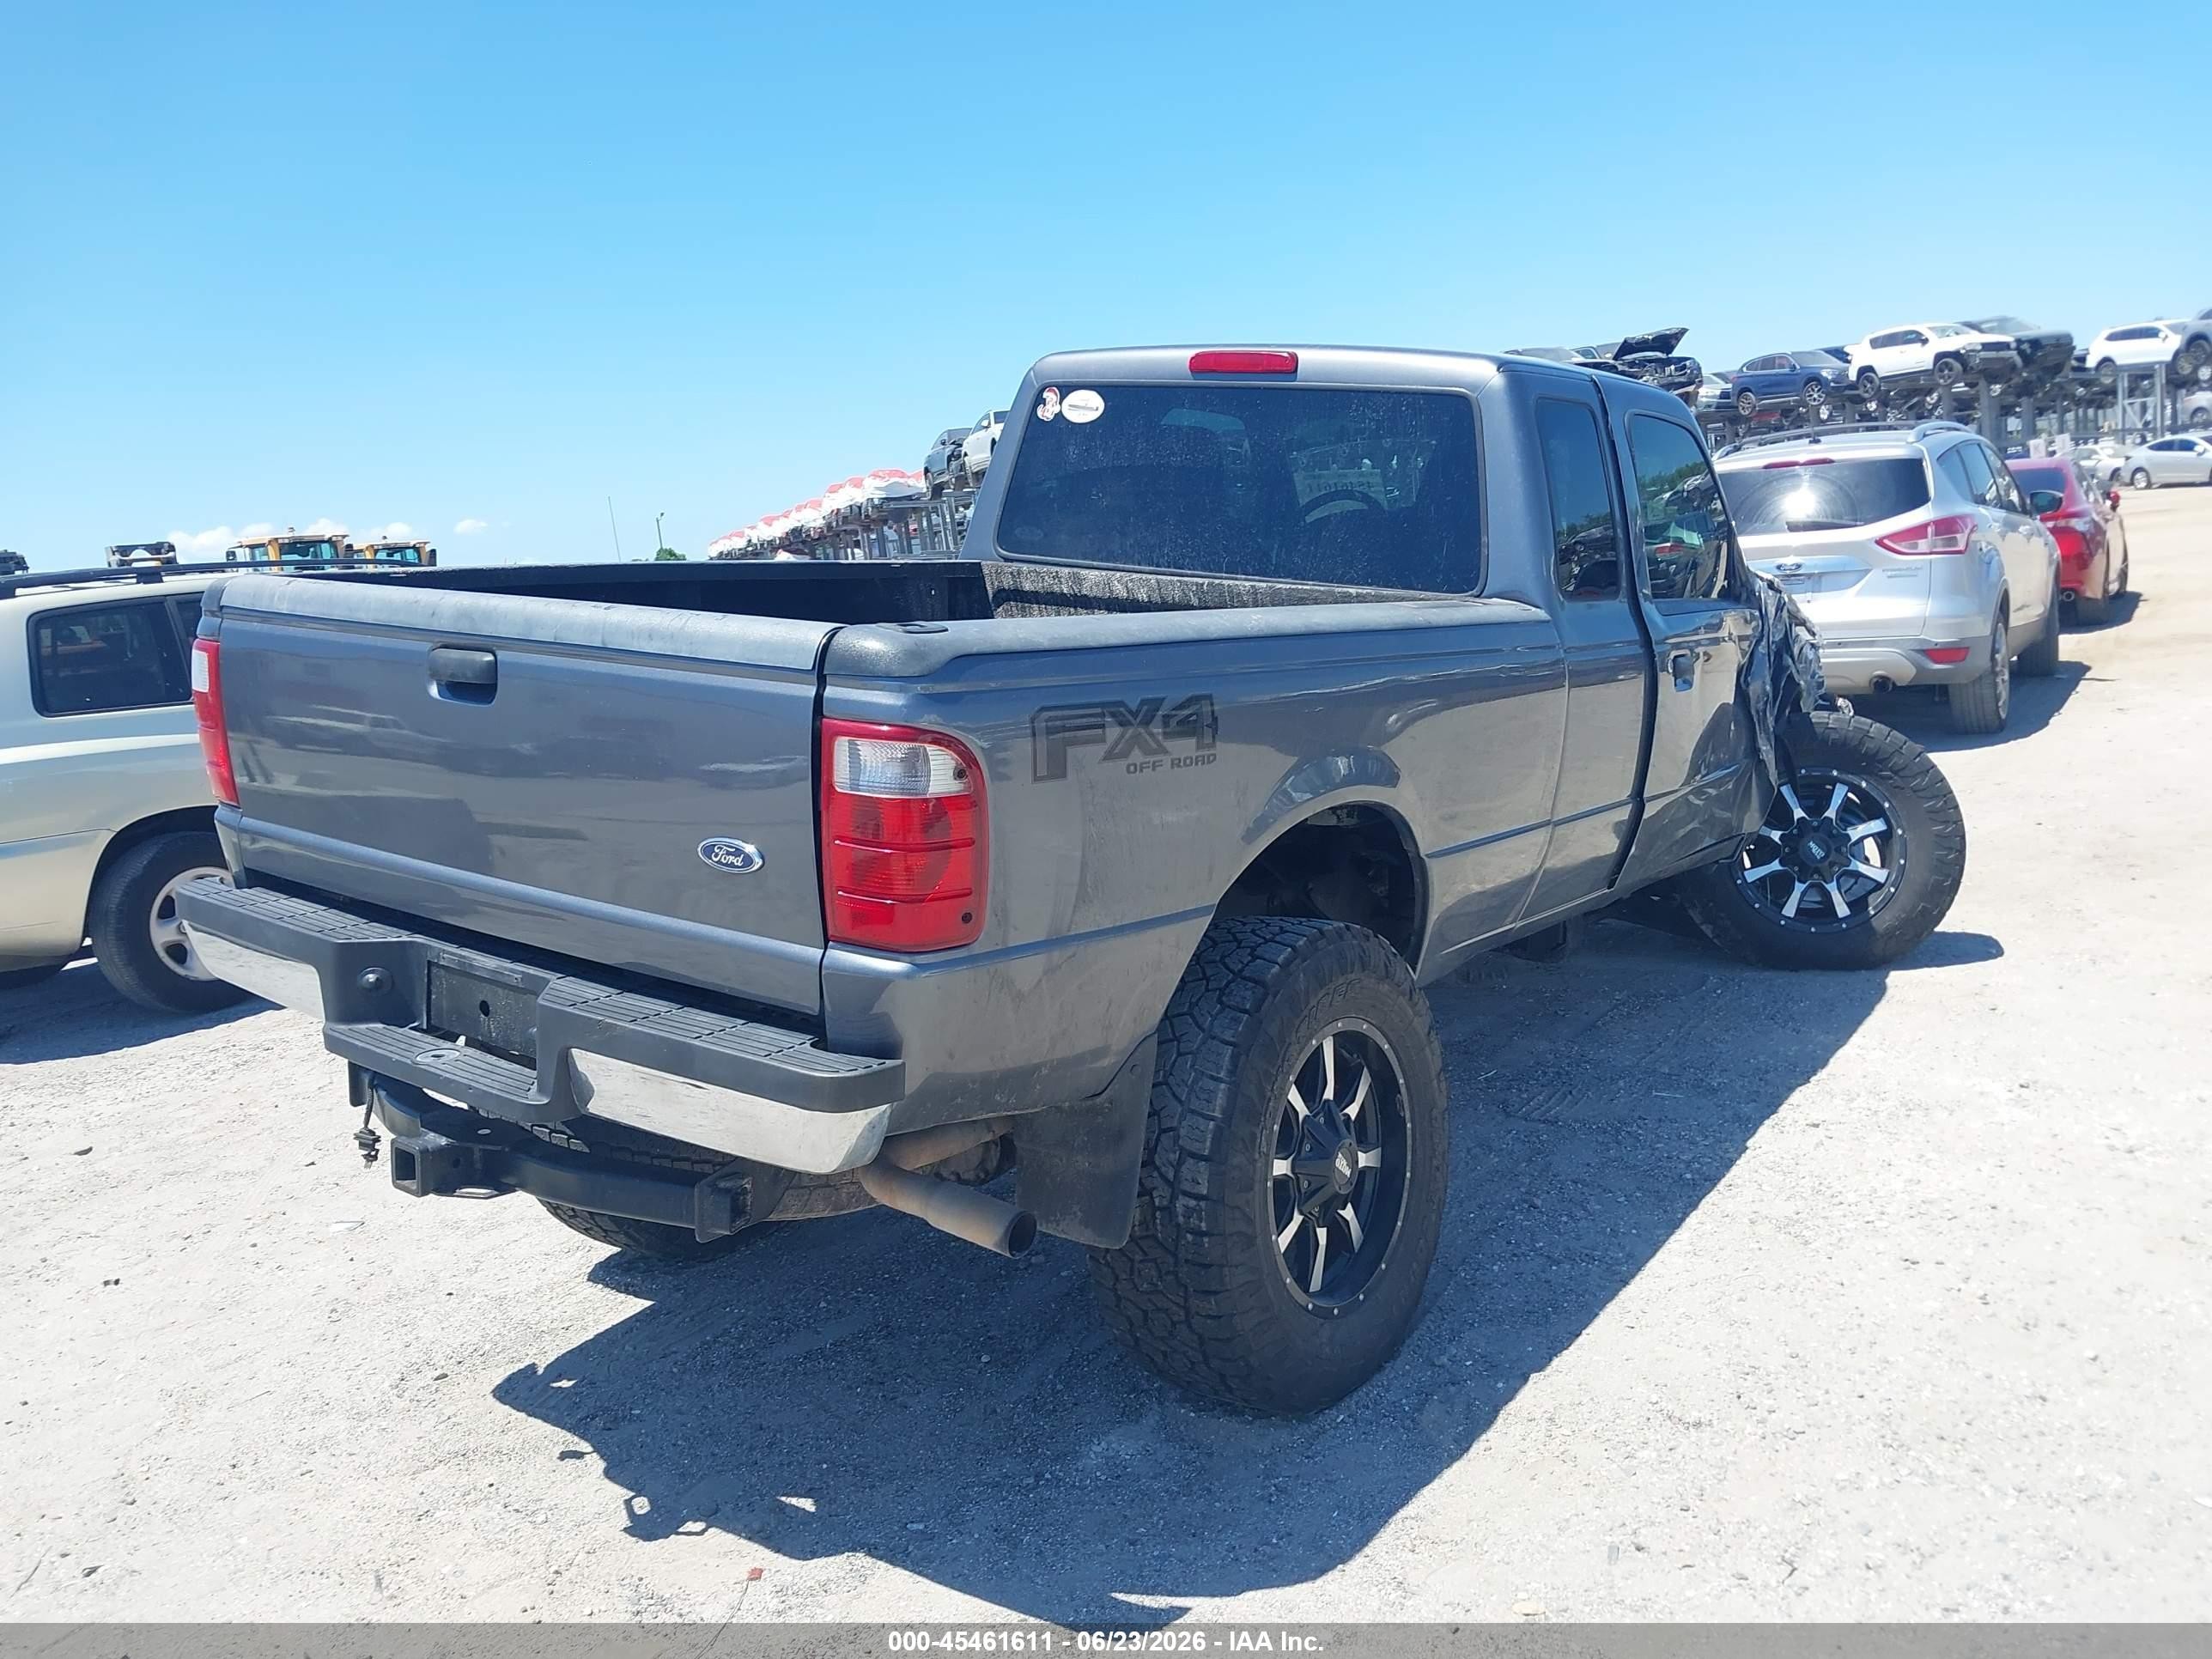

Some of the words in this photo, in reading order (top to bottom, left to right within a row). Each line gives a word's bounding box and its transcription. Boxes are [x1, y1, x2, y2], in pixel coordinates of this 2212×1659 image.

[1031, 693, 1218, 783] FX4
[1126, 759, 1164, 775] OFF
[1170, 753, 1217, 769] ROAD
[711, 844, 744, 866] Ford
